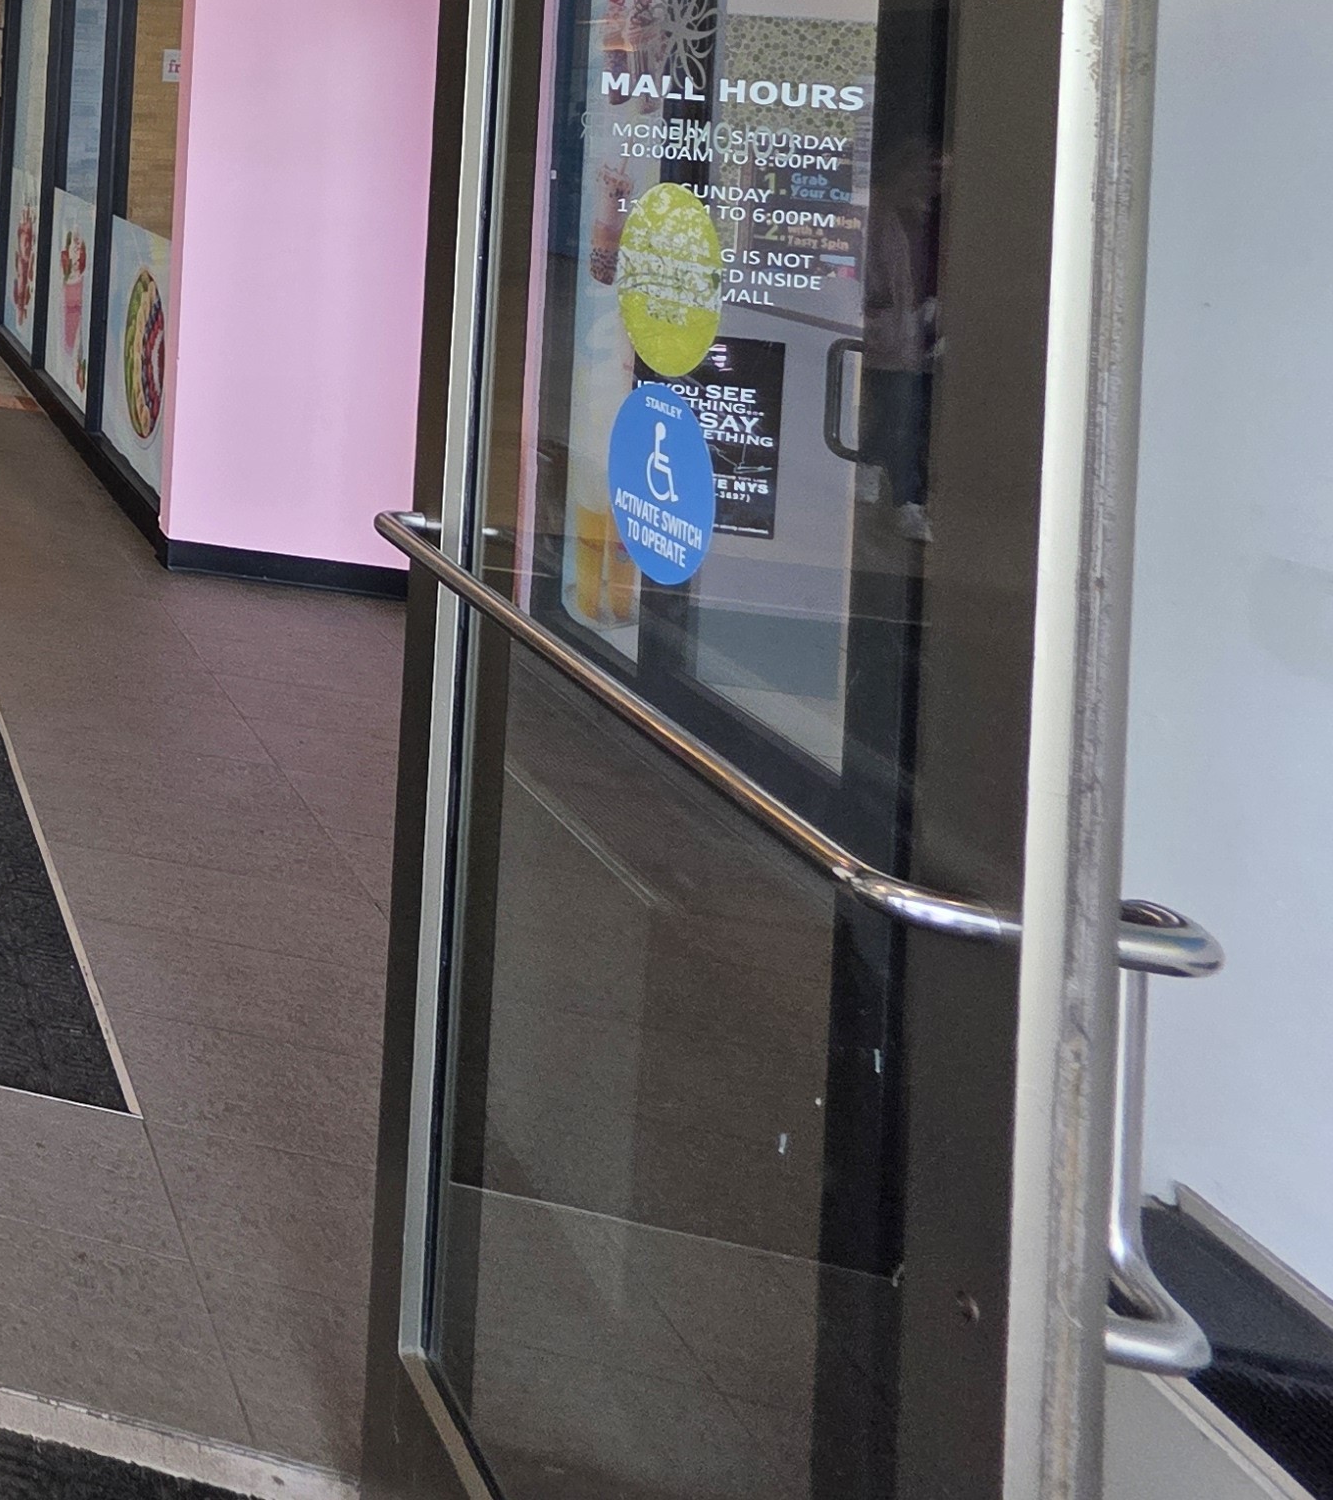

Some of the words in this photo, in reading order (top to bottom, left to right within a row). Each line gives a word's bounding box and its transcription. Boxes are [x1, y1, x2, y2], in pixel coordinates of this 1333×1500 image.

[600, 71, 706, 102] MALL
[718, 78, 866, 111] HOURS
[612, 122, 709, 143] MONDAY
[731, 130, 848, 153] SATURDAY
[620, 142, 713, 163] 10:00AM
[791, 172, 828, 186] Grab
[717, 204, 746, 222] TO
[752, 208, 835, 228] 6:00PM
[742, 248, 761, 265] IS
[767, 252, 815, 269] NOT
[750, 271, 822, 290] INSIDE
[705, 384, 757, 404] SEE
[699, 411, 760, 434] SAY
[703, 429, 774, 448] ETHING
[734, 480, 769, 495] NYS
[614, 486, 660, 529] ACTIVATE
[661, 509, 703, 551] SWITCH
[627, 517, 640, 541] TO
[641, 526, 687, 569] OPERATE
